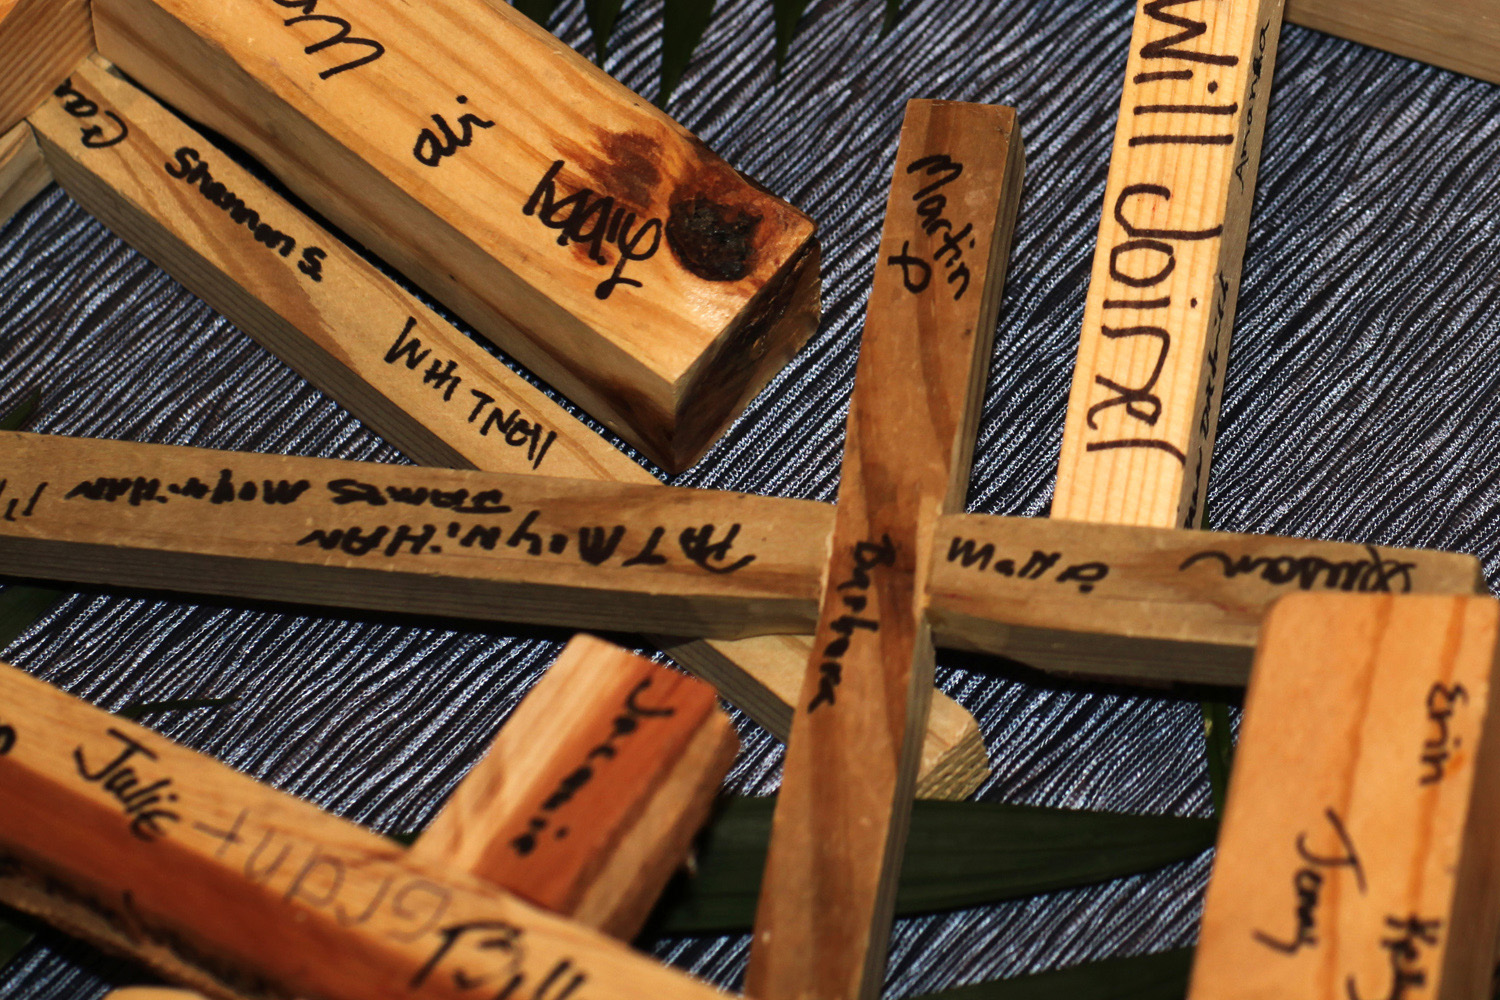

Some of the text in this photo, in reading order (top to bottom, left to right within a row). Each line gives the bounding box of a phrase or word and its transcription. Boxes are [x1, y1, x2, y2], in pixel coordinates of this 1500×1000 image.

[164, 146, 298, 258] Shannon
[906, 154, 972, 300] Martin
[1085, 183, 1223, 470] Joiner
[1418, 680, 1470, 787] Erin
